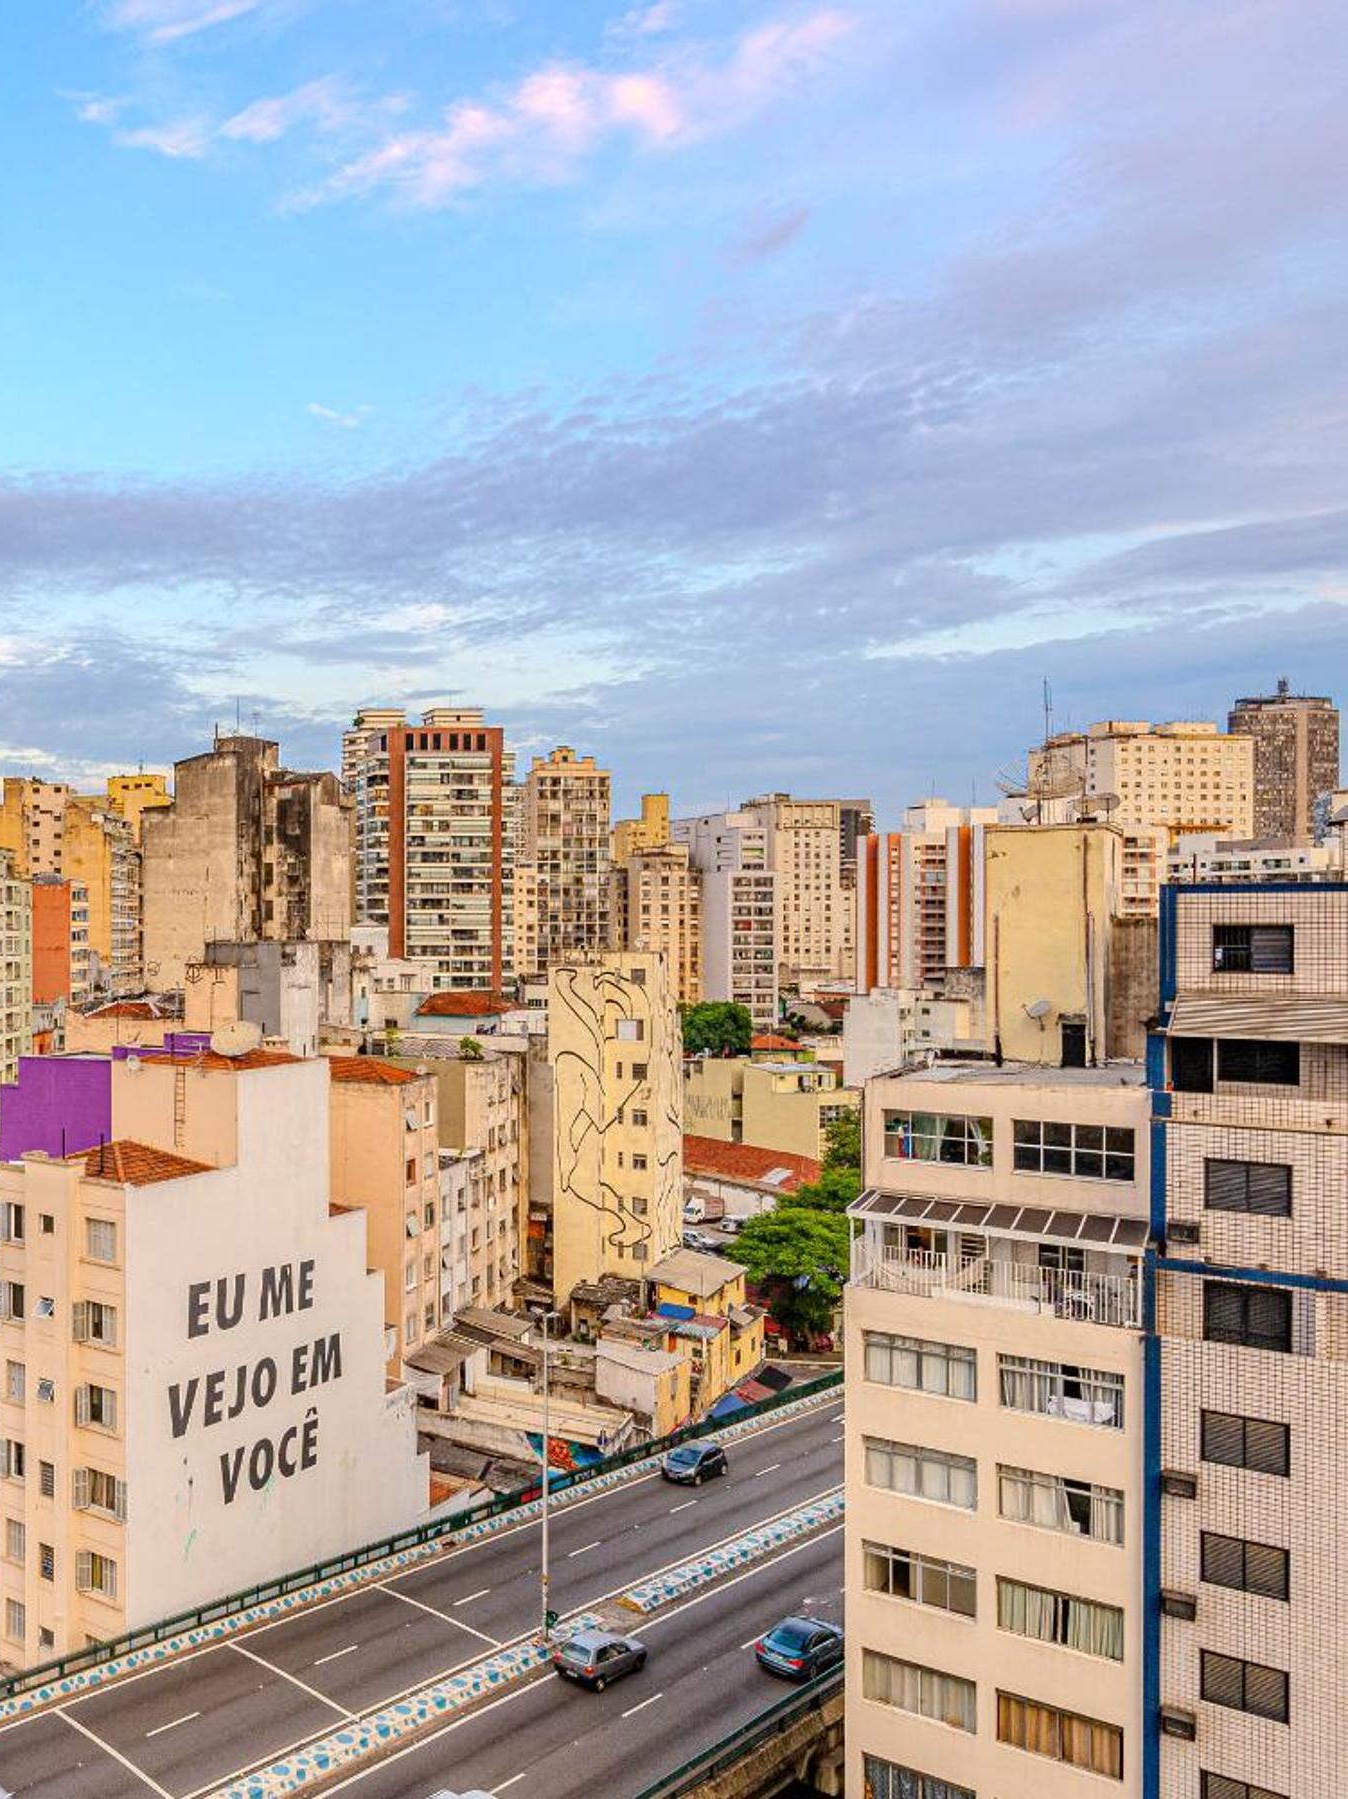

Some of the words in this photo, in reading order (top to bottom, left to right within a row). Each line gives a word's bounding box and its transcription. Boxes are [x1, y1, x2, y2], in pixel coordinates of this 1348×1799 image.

[188, 1273, 246, 1339] EU
[258, 1259, 315, 1322] ME
[168, 1356, 277, 1438] VEJO
[291, 1333, 342, 1395] EM
[219, 1406, 319, 1505] VOCÊ
